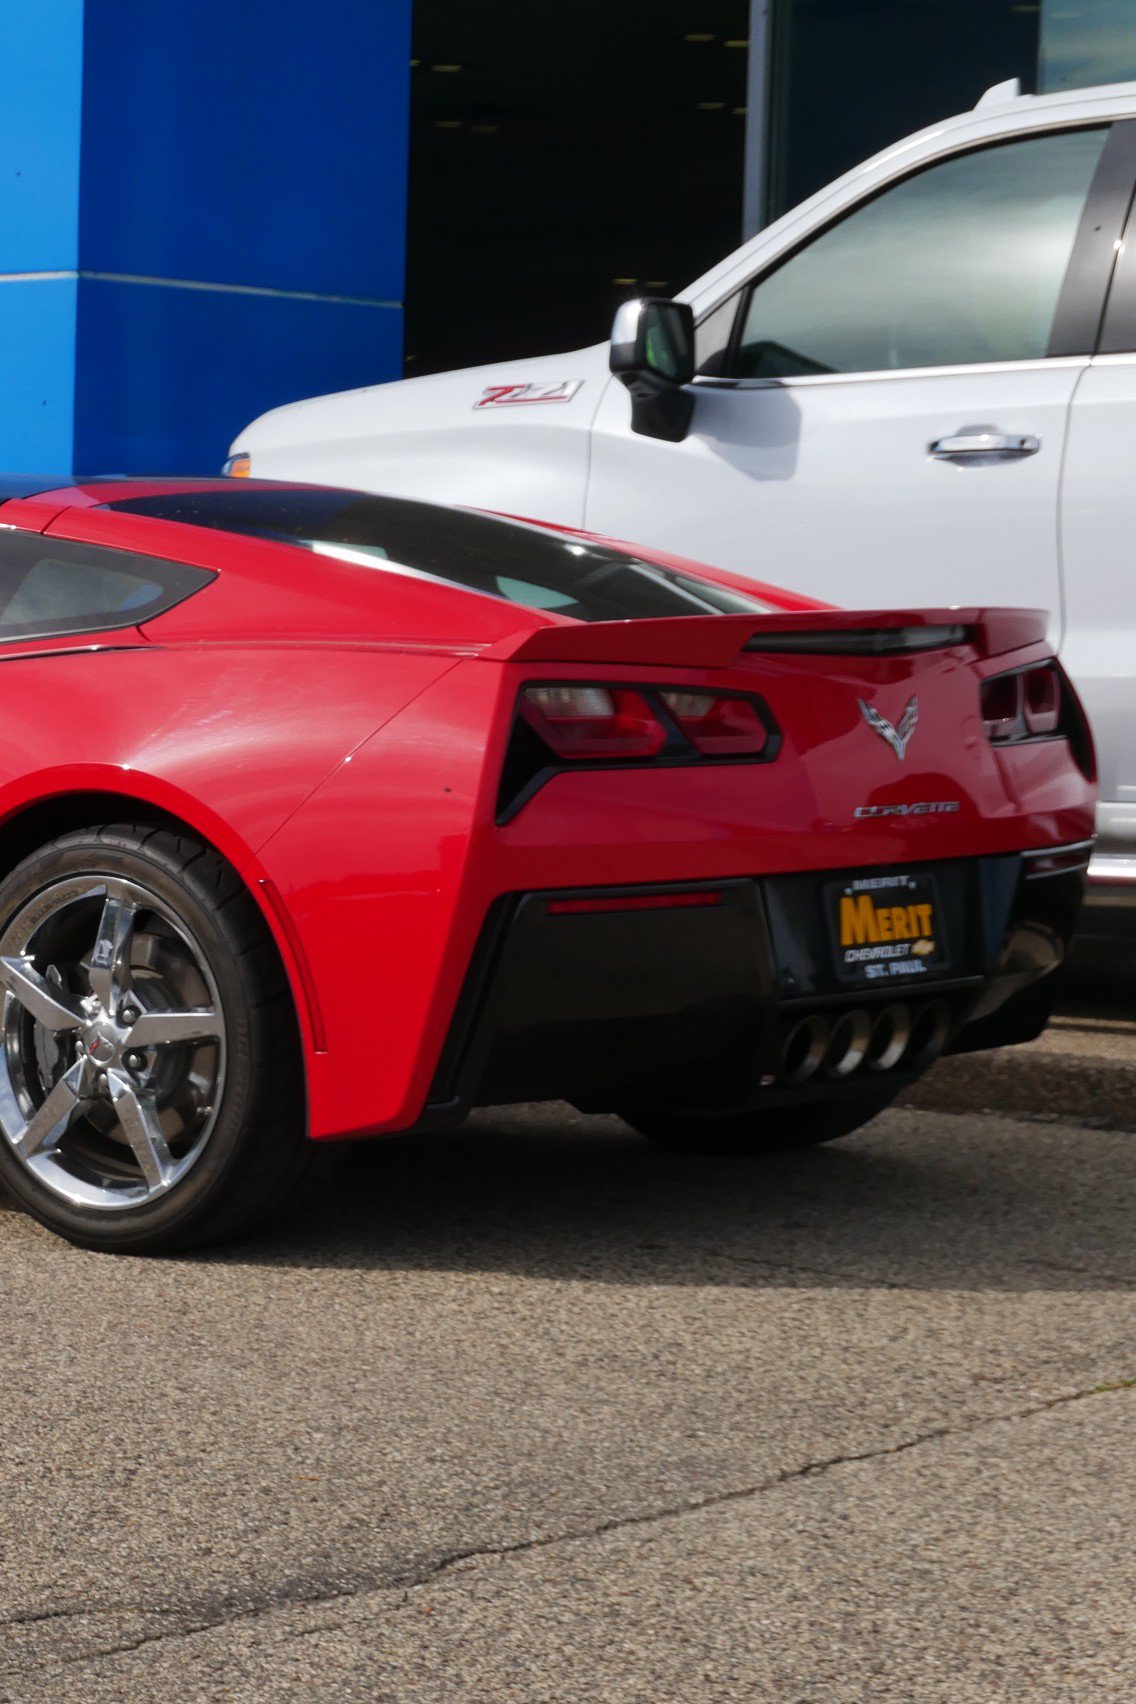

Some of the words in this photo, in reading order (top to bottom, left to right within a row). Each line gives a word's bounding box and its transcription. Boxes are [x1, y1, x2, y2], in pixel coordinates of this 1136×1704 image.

[853, 801, 960, 818] CORVETTE
[840, 895, 932, 946] MERIT
[844, 943, 911, 962] CHEVROLET
